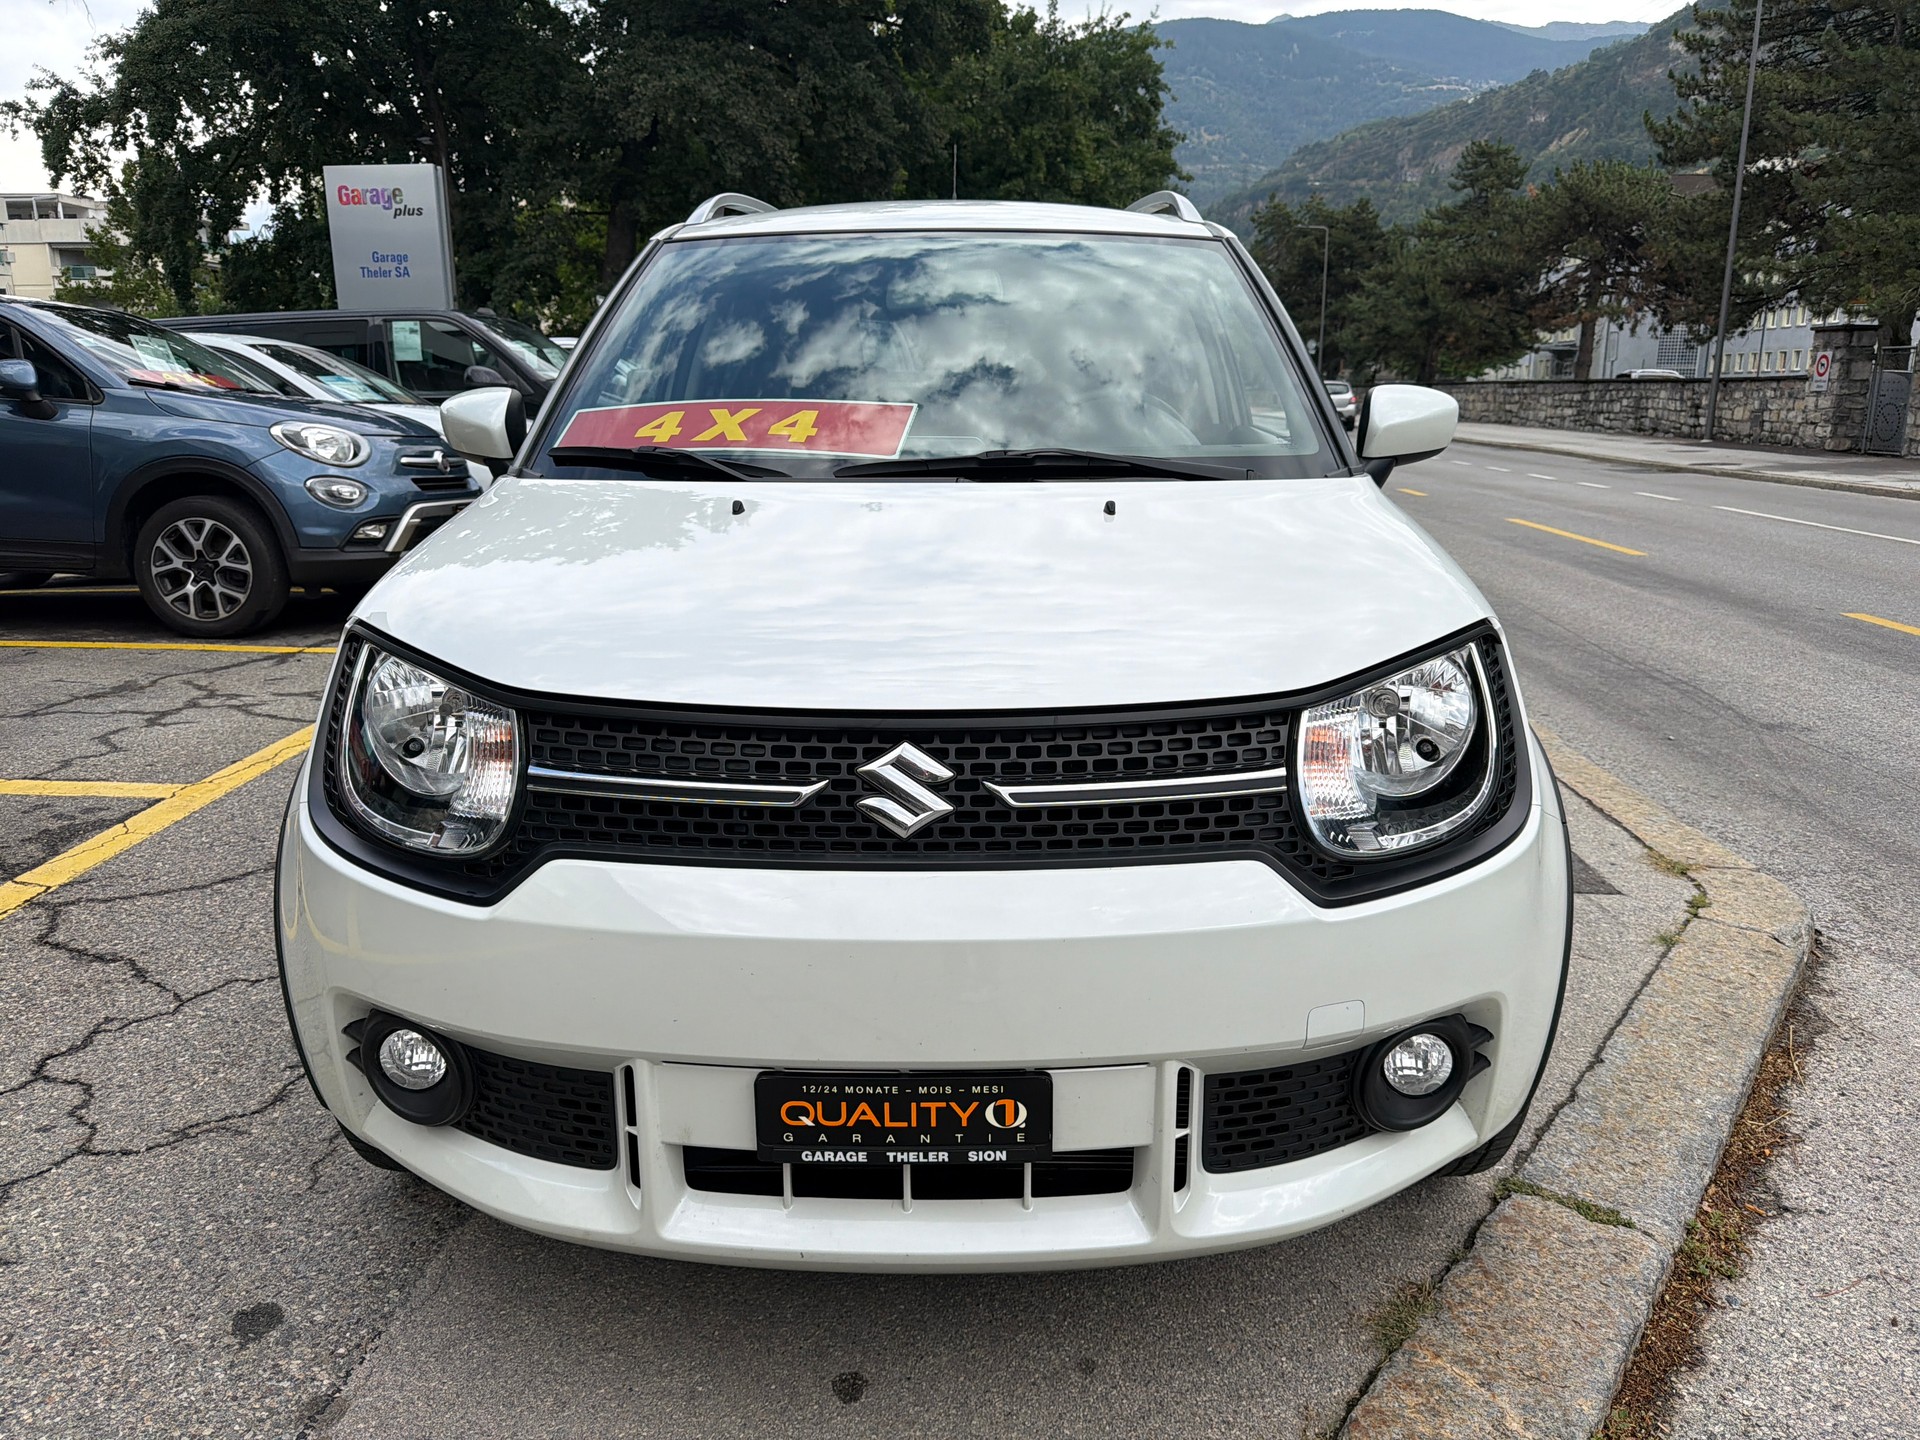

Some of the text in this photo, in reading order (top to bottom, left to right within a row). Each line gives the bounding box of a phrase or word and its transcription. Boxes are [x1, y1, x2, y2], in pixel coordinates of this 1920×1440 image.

[337, 185, 404, 210] Garage
[393, 204, 424, 219] plus
[371, 251, 409, 265] Garage
[360, 266, 411, 278] Theler SA
[802, 1085, 838, 1094] 12/24
[845, 1085, 899, 1094] MONATE
[918, 1085, 952, 1094] MOIS
[972, 1085, 1004, 1094] MESI
[781, 1100, 980, 1128] QUALITY
[783, 1132, 1025, 1144] GARANTIE
[801, 1150, 1007, 1162] GARAGE THELER SION
